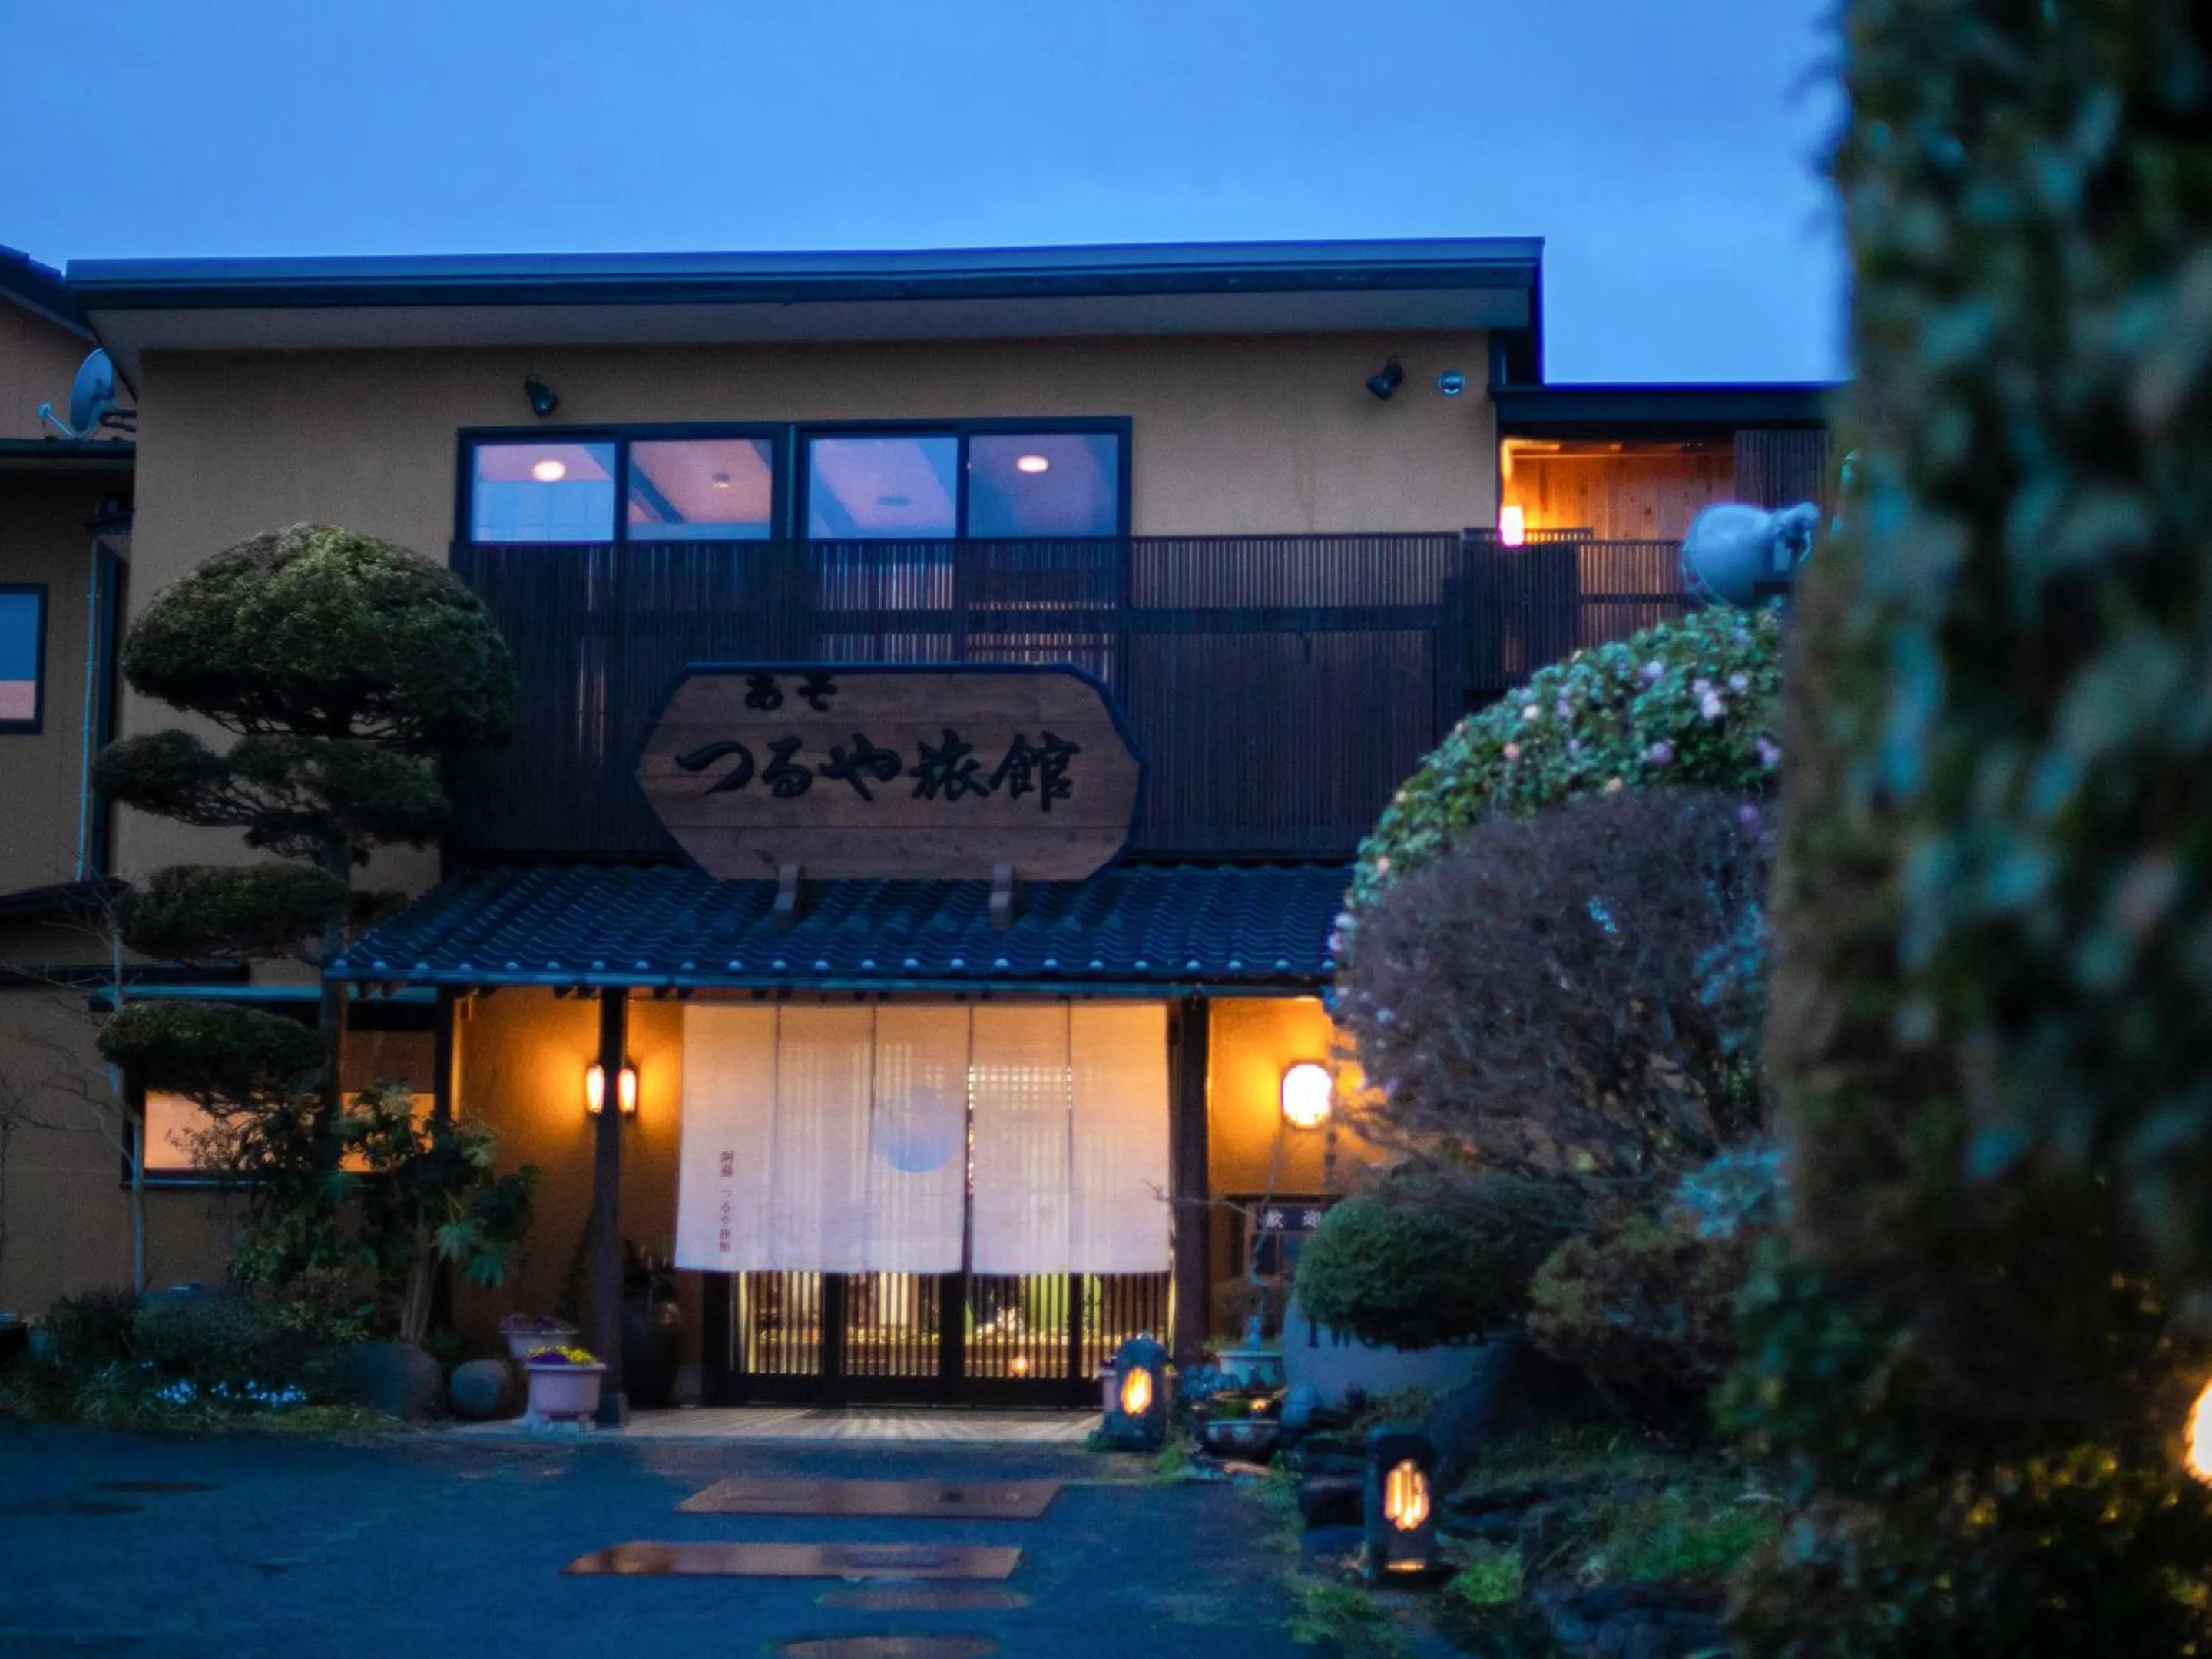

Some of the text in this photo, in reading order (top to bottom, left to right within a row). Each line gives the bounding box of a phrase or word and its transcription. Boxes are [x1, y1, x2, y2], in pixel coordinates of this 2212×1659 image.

[744, 671, 839, 712] あそ
[675, 728, 1081, 811] つるや旅館
